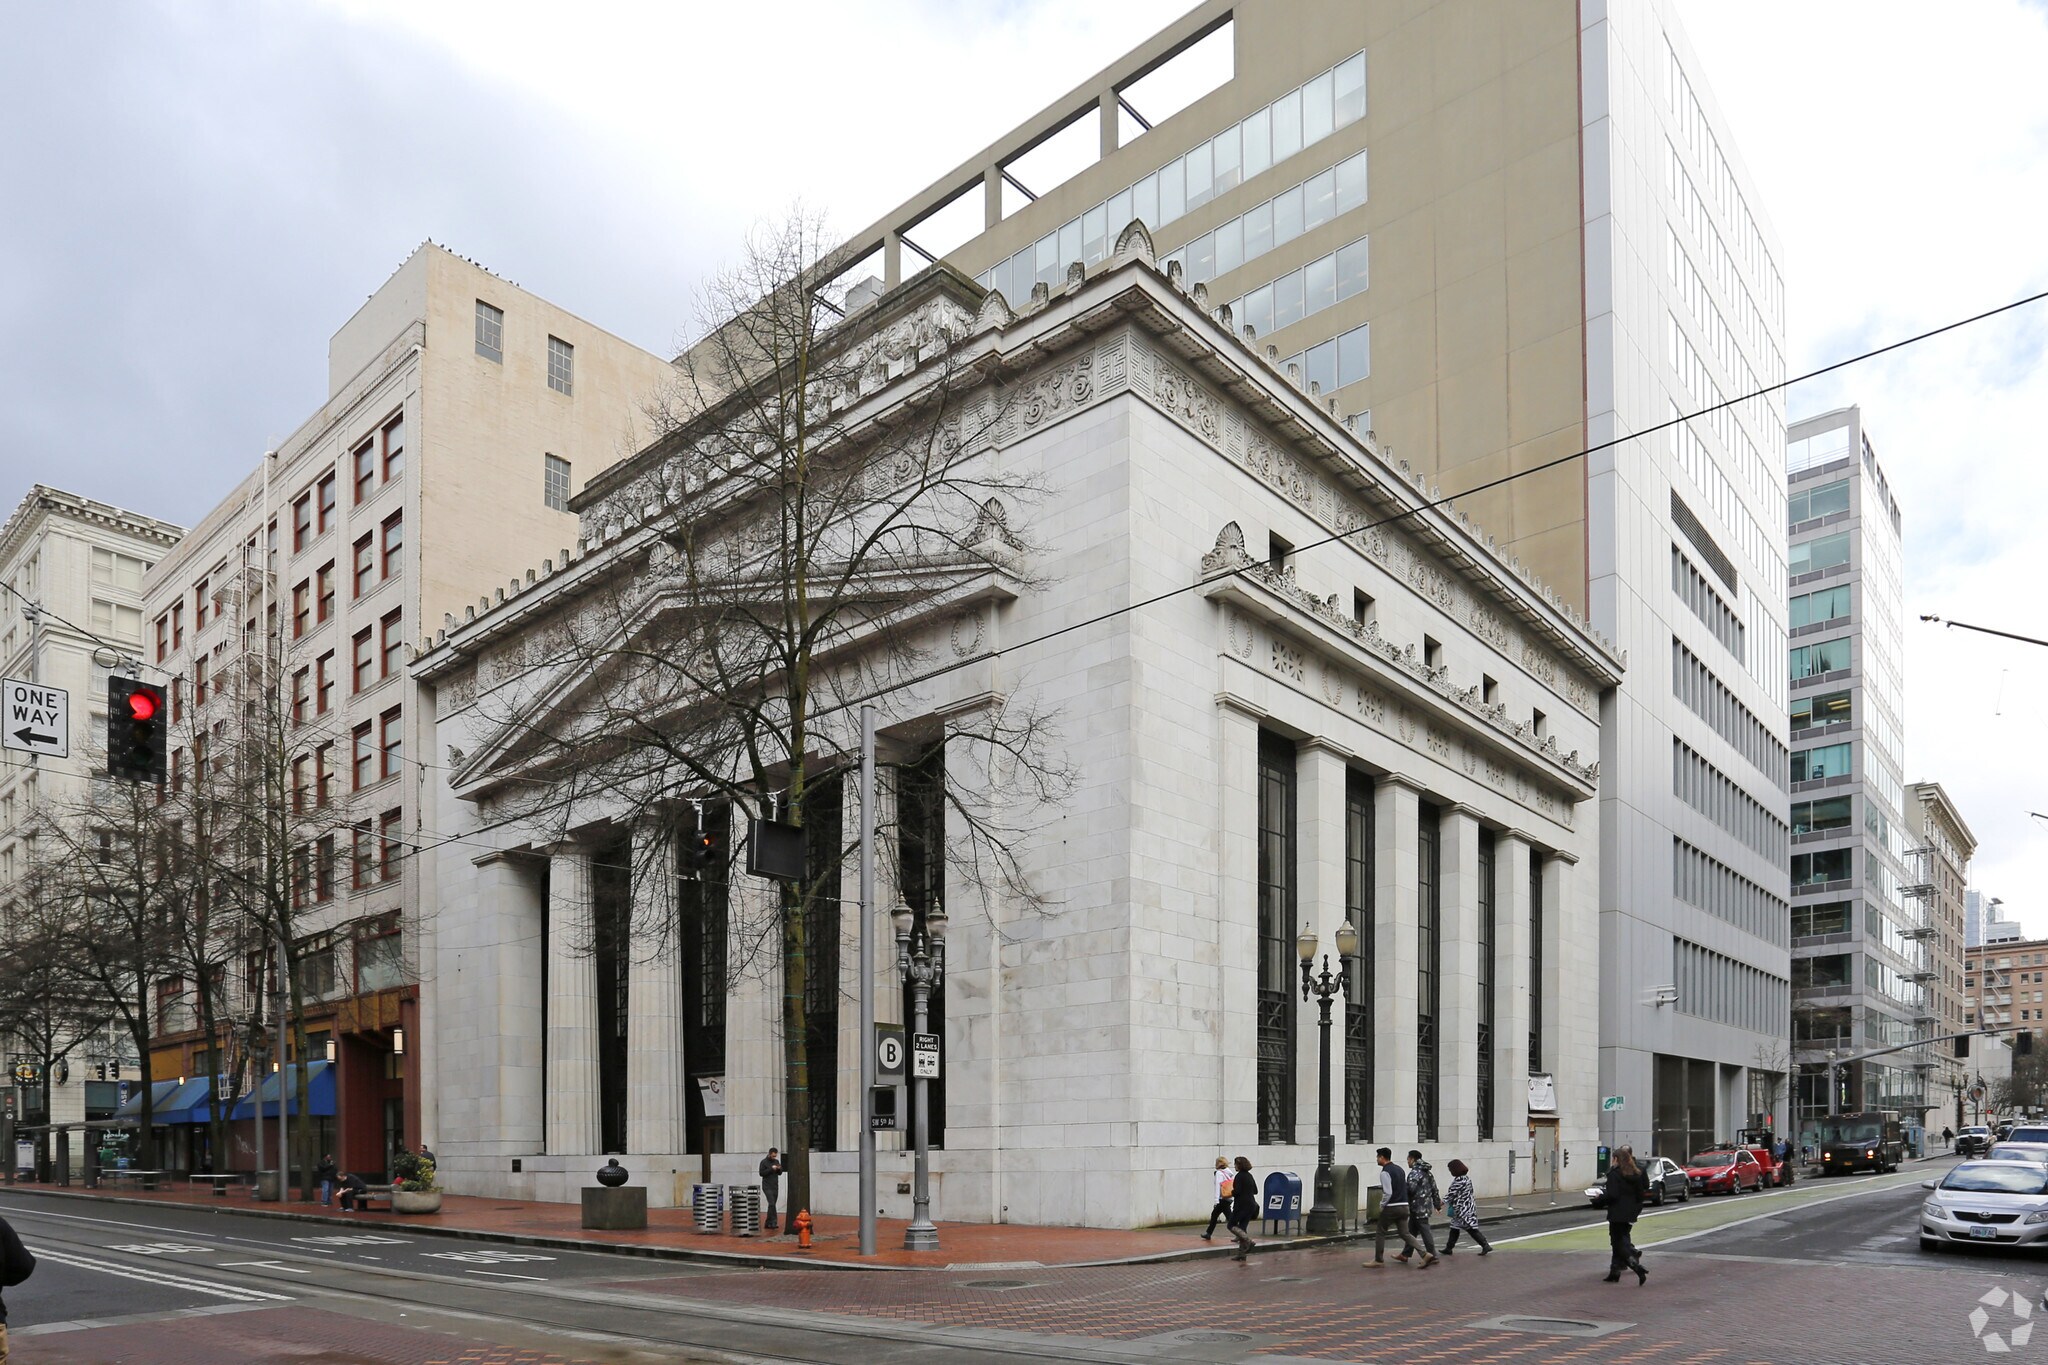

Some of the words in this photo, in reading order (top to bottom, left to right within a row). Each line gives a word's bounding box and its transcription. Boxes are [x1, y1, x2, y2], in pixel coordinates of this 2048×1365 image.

[15, 687, 57, 709] ONE
[13, 705, 59, 726] WAY
[886, 1043, 897, 1063] B
[872, 1118, 879, 1126] SW
[102, 1243, 215, 1254] BUS
[420, 1250, 557, 1264] BUS
